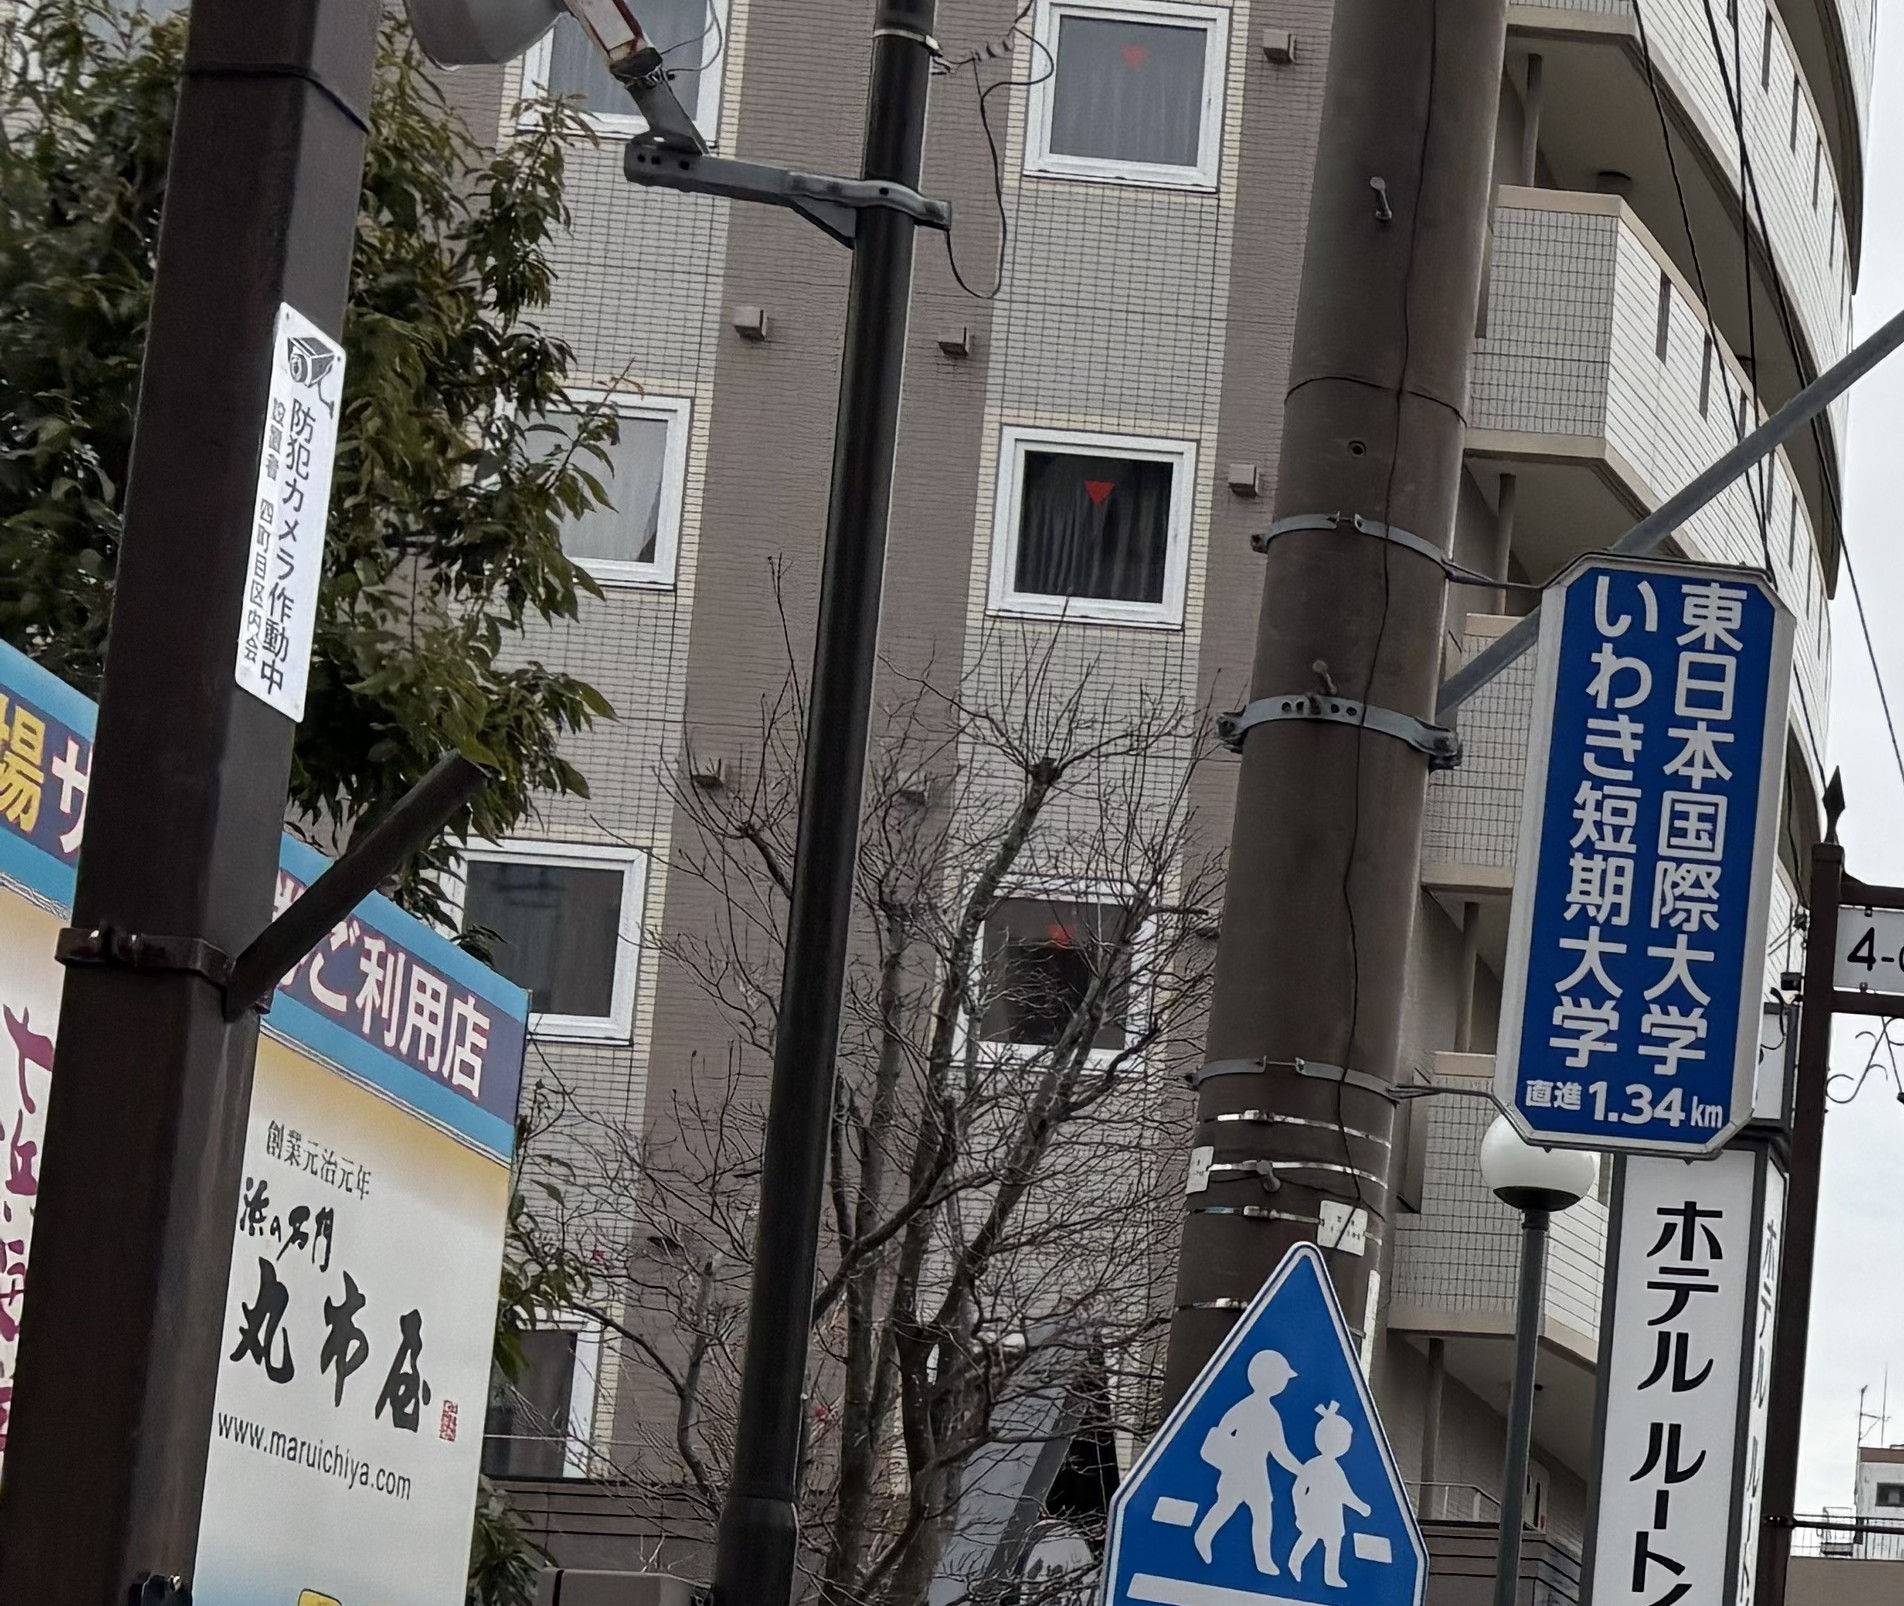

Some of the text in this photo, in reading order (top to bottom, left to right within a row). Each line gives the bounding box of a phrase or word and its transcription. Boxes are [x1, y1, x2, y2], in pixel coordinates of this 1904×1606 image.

[261, 398, 315, 695] 防犯カメラ作動中
[1548, 574, 1659, 1070] いわき短期大学
[1638, 581, 1748, 1077] 東日本国際大学
[266, 1120, 371, 1201] 創業元治元年
[230, 1257, 431, 1433] 丸市屋
[1637, 1200, 1724, 1393] ホテル
[218, 1412, 411, 1500] www.maruichiya.com
